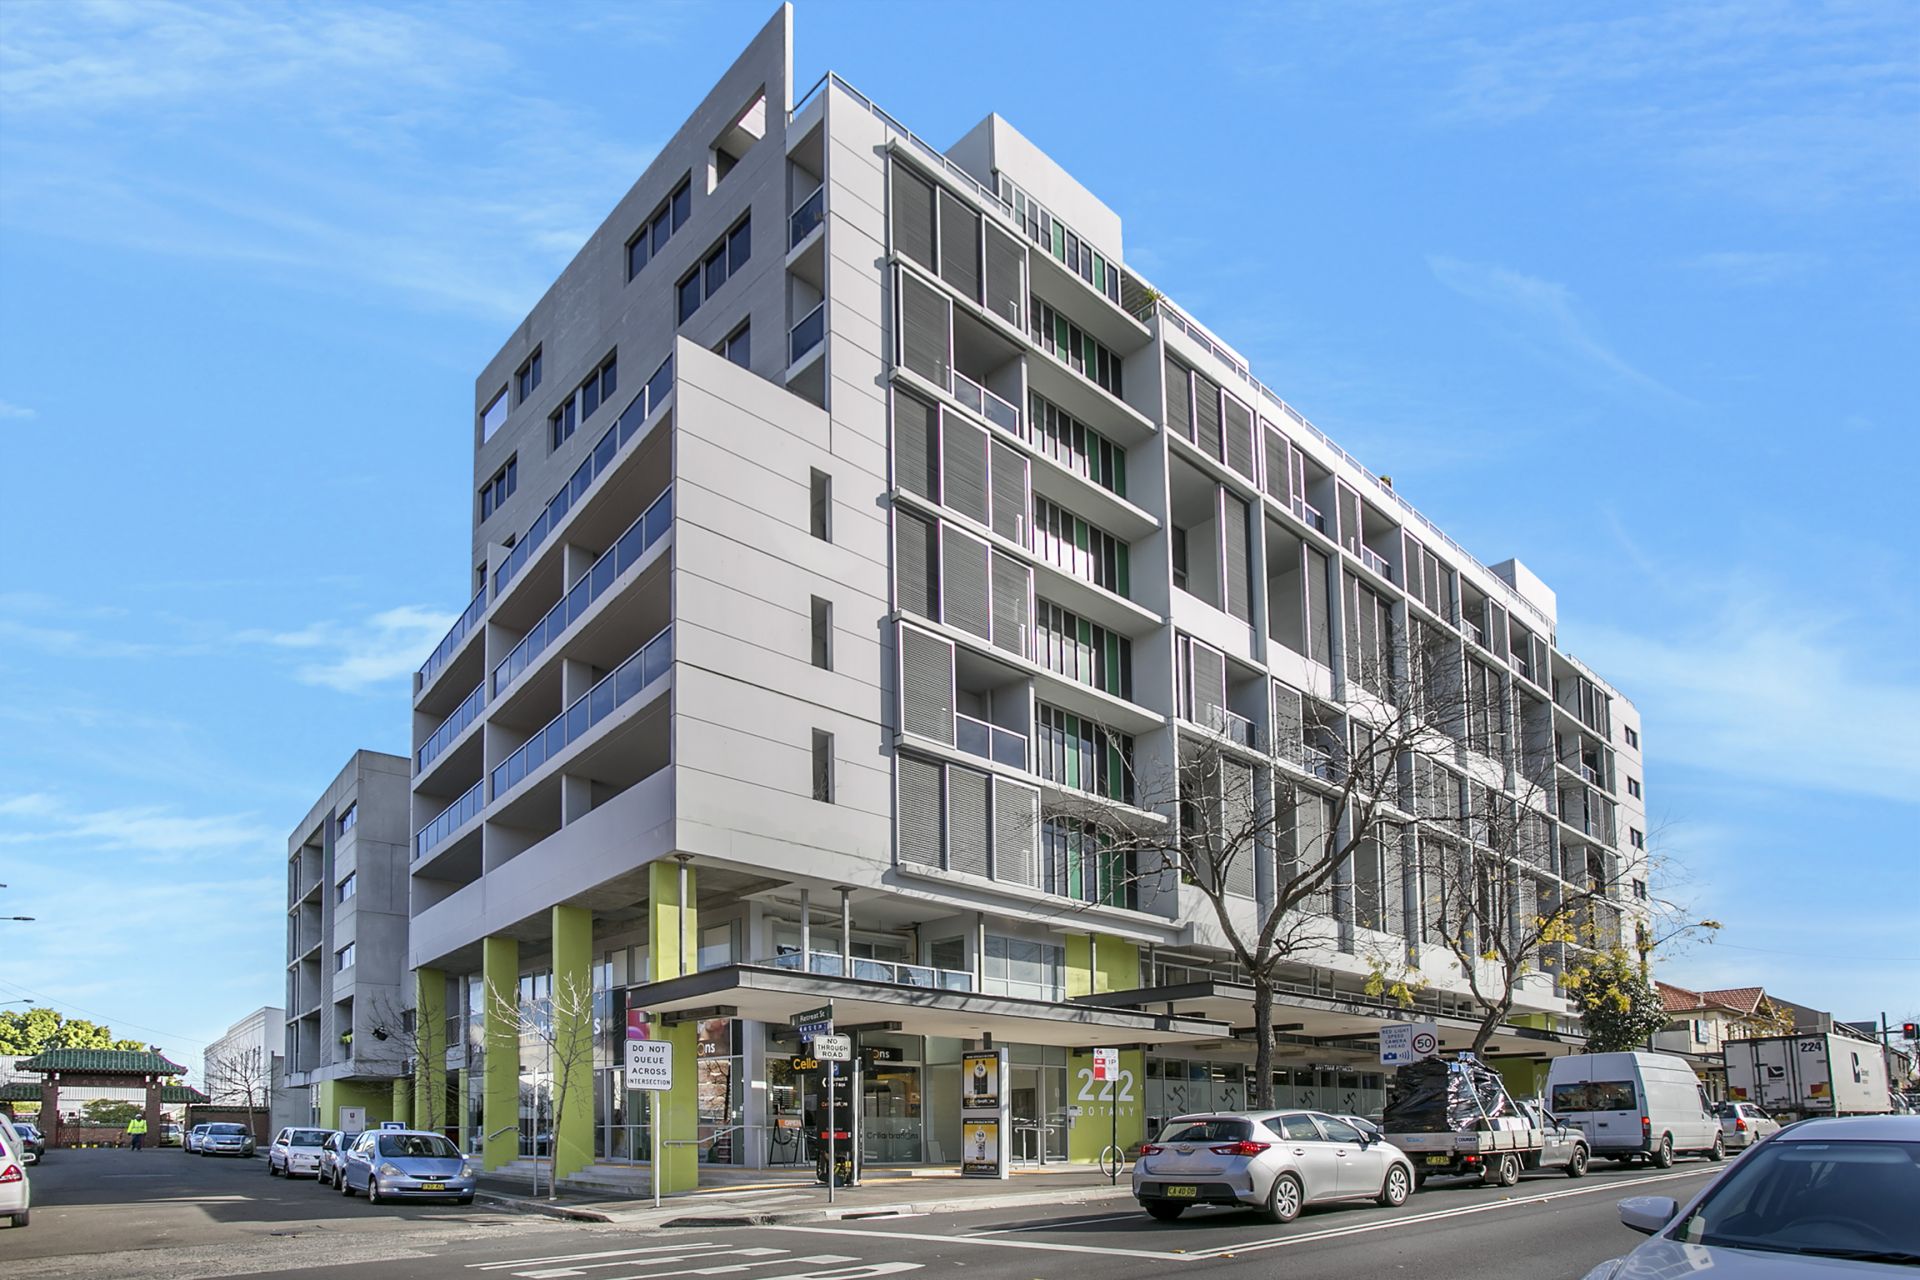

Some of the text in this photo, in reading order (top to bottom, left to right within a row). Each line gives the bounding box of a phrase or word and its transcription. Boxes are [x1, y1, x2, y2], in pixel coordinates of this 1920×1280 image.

[1417, 1038, 1432, 1048] 50
[1800, 1042, 1822, 1052] 224
[634, 1056, 664, 1064] QUEUE
[1078, 1068, 1134, 1101] 222
[1077, 1106, 1134, 1116] BOTANY
